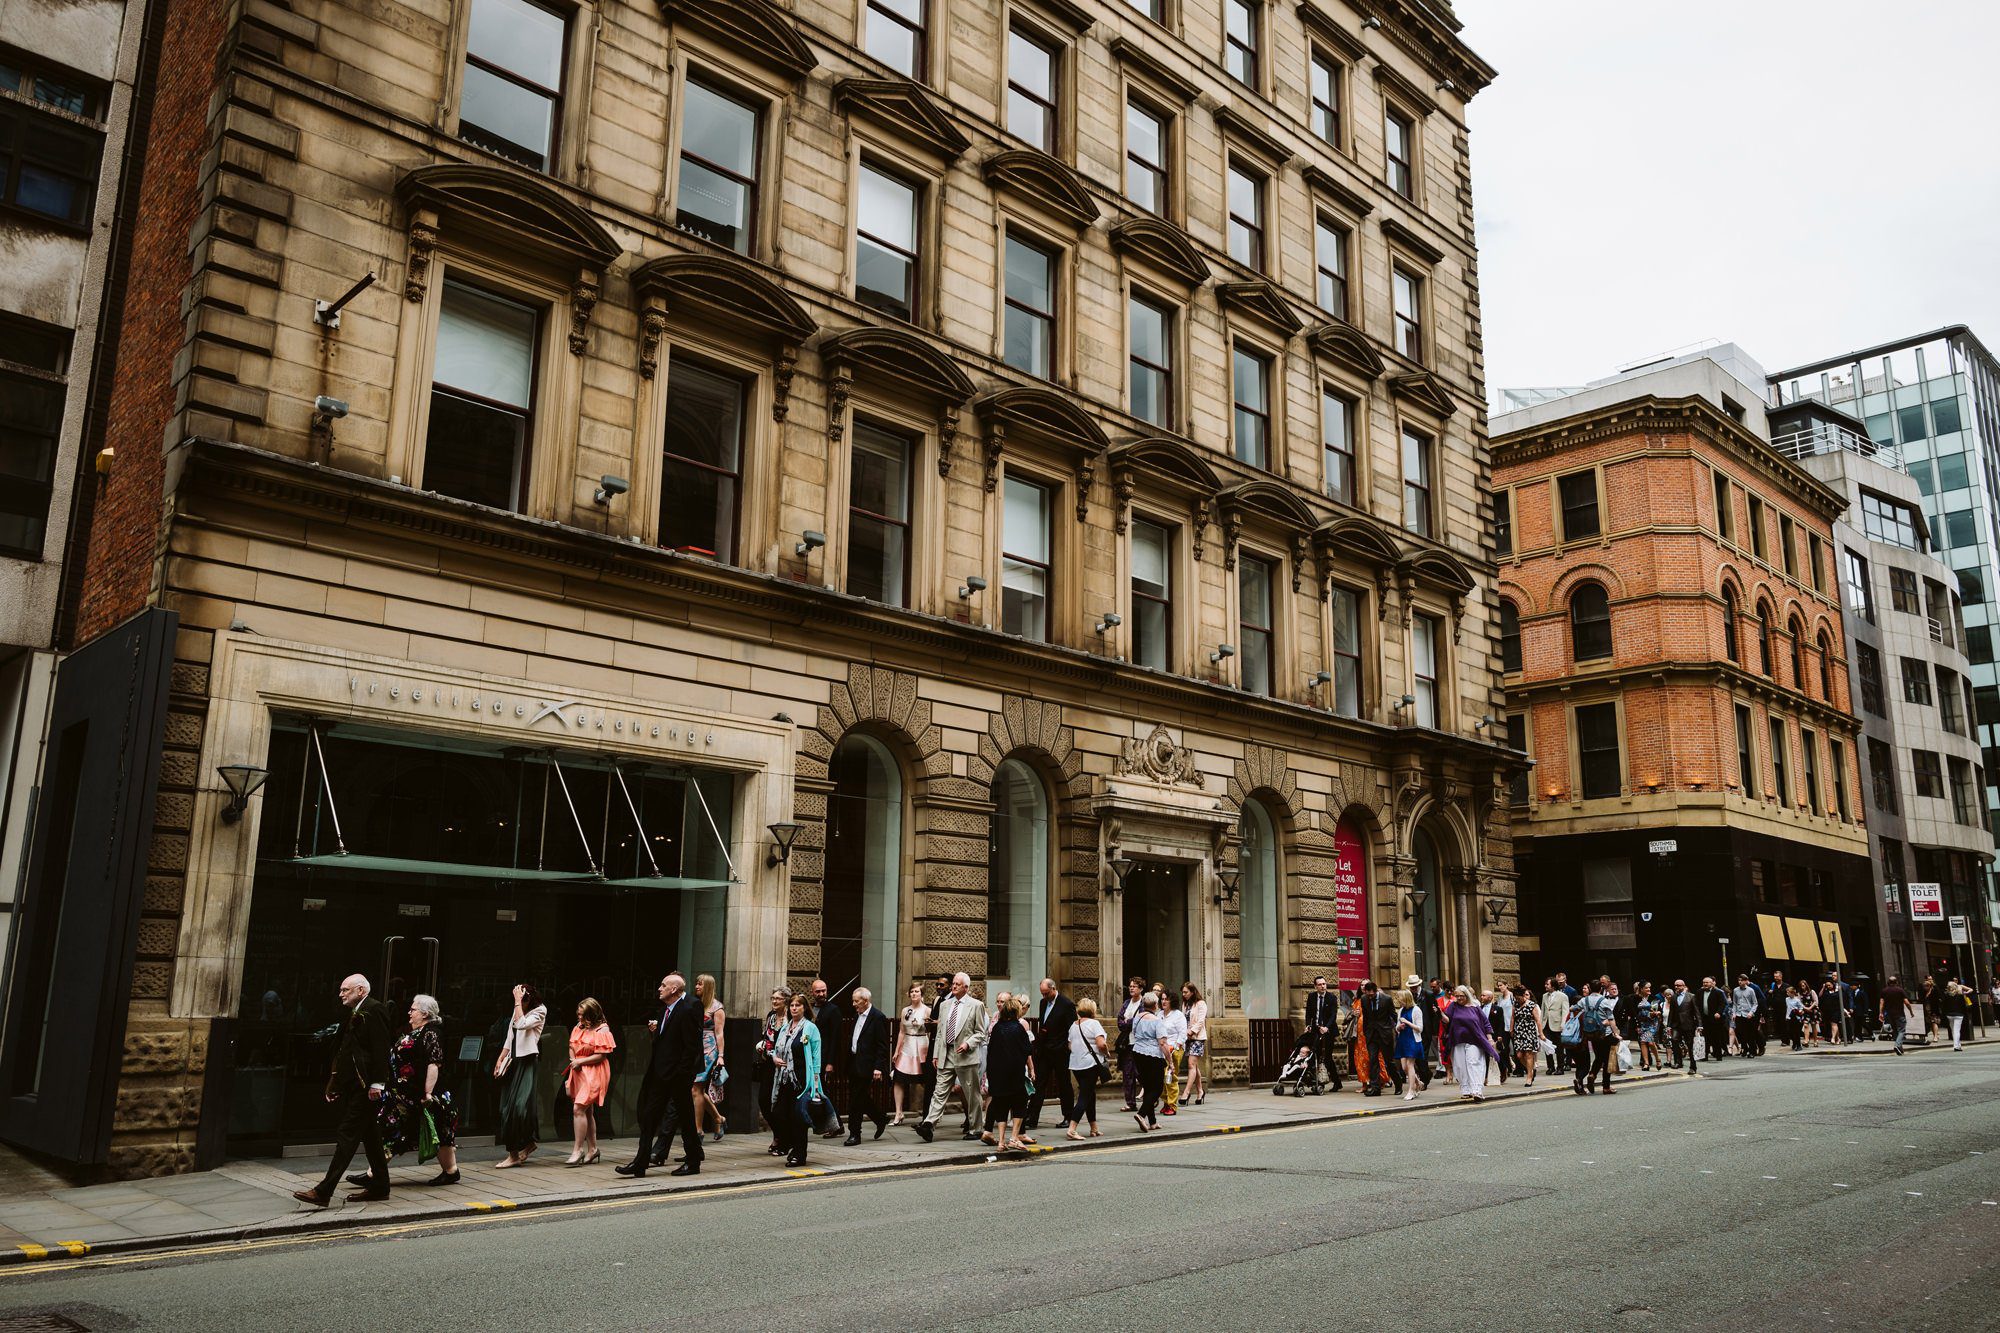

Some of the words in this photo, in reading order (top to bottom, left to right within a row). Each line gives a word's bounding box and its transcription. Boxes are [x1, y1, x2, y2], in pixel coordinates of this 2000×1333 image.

[350, 677, 525, 716] freetrade
[578, 713, 714, 744] exchange
[1339, 859, 1351, 871] Let
